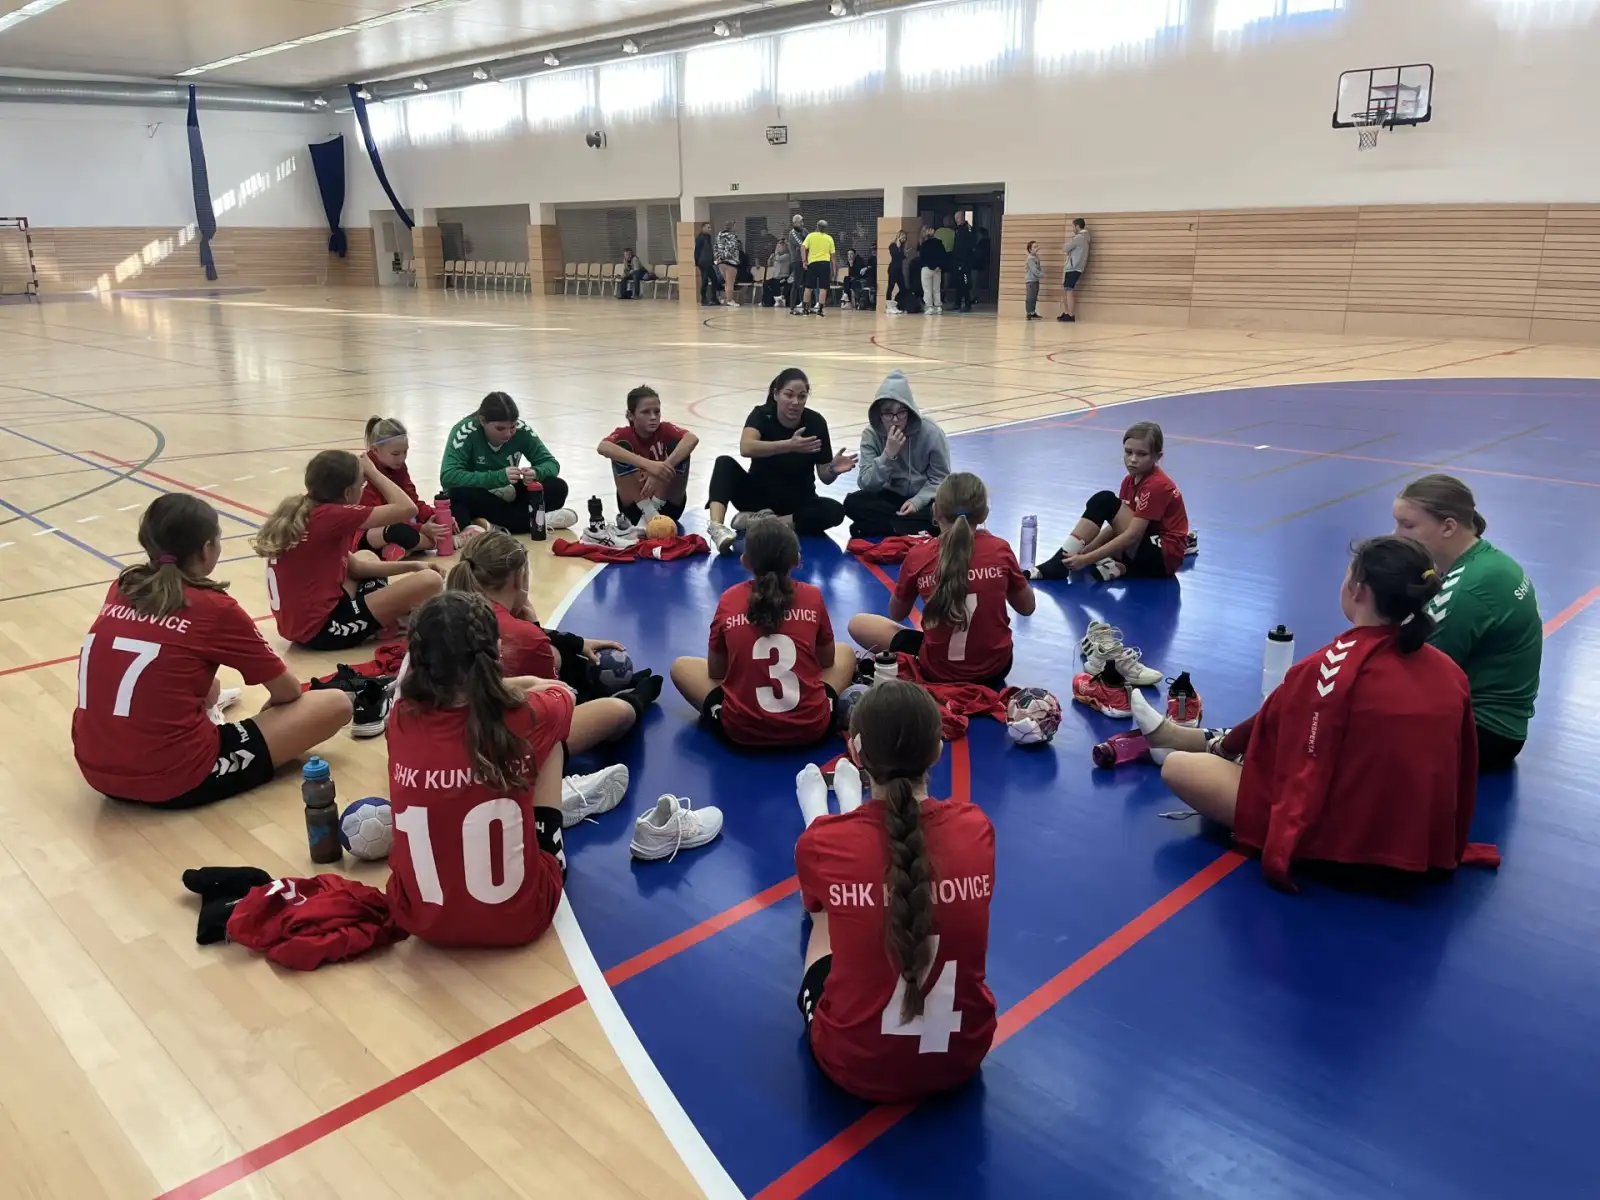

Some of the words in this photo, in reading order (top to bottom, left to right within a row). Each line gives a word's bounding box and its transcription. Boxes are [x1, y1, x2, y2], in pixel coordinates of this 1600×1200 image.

[917, 574, 937, 589] SHK
[725, 613, 750, 629] SHK
[78, 632, 162, 718] 17
[752, 634, 800, 713] 3
[393, 762, 419, 788] SHK
[394, 797, 526, 907] 10
[828, 882, 876, 907] SHK
[880, 933, 963, 1055] 4
